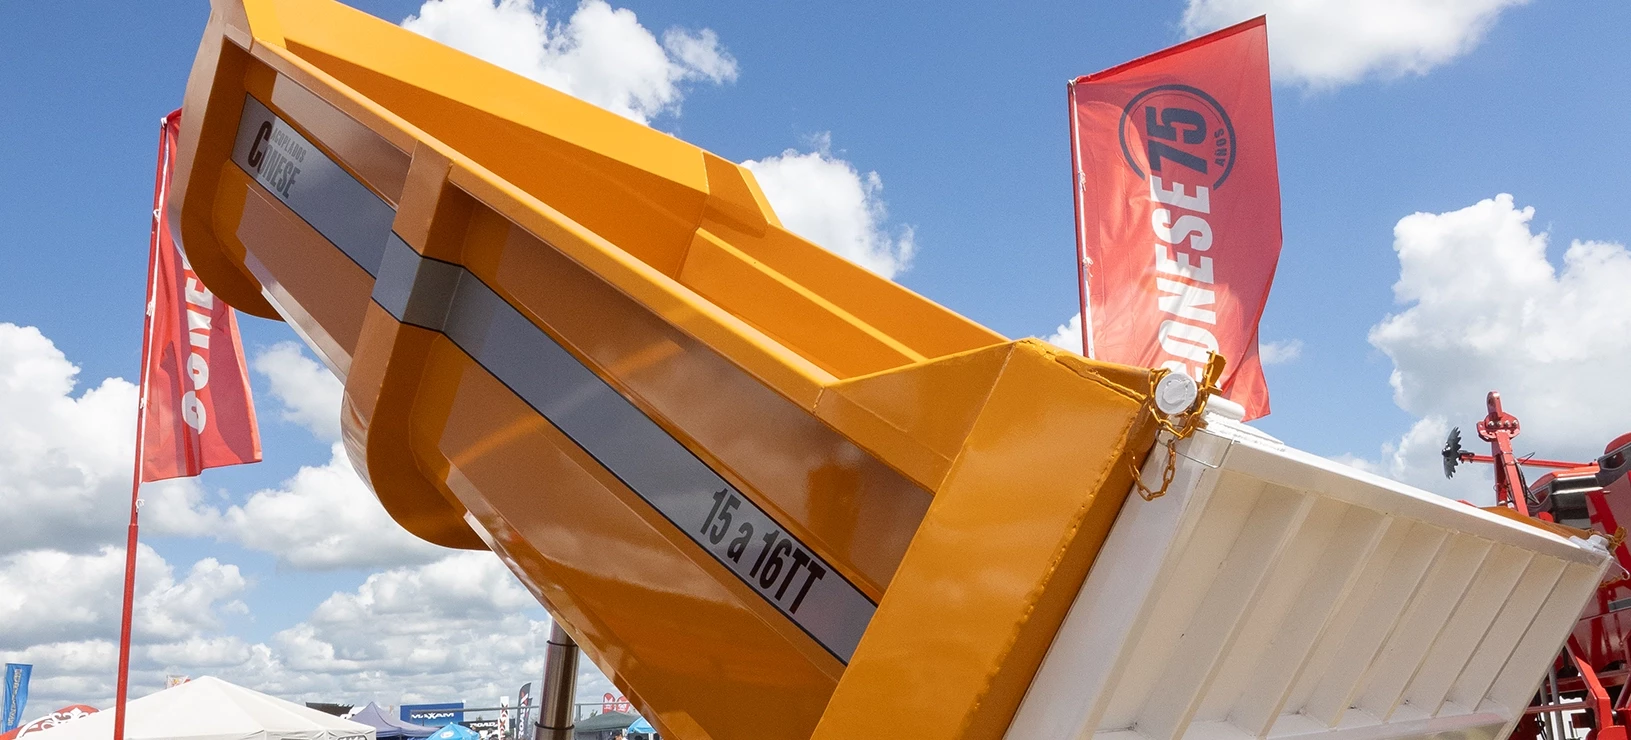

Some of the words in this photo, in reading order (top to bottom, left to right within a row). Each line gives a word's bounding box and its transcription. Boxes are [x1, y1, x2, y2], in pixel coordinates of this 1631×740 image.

[247, 120, 302, 199] CONESE
[270, 127, 307, 163] ACOPLADOS
[1145, 106, 1207, 175] 75
[700, 487, 742, 545] 15
[726, 521, 754, 564] a
[749, 529, 827, 615] 16TT
